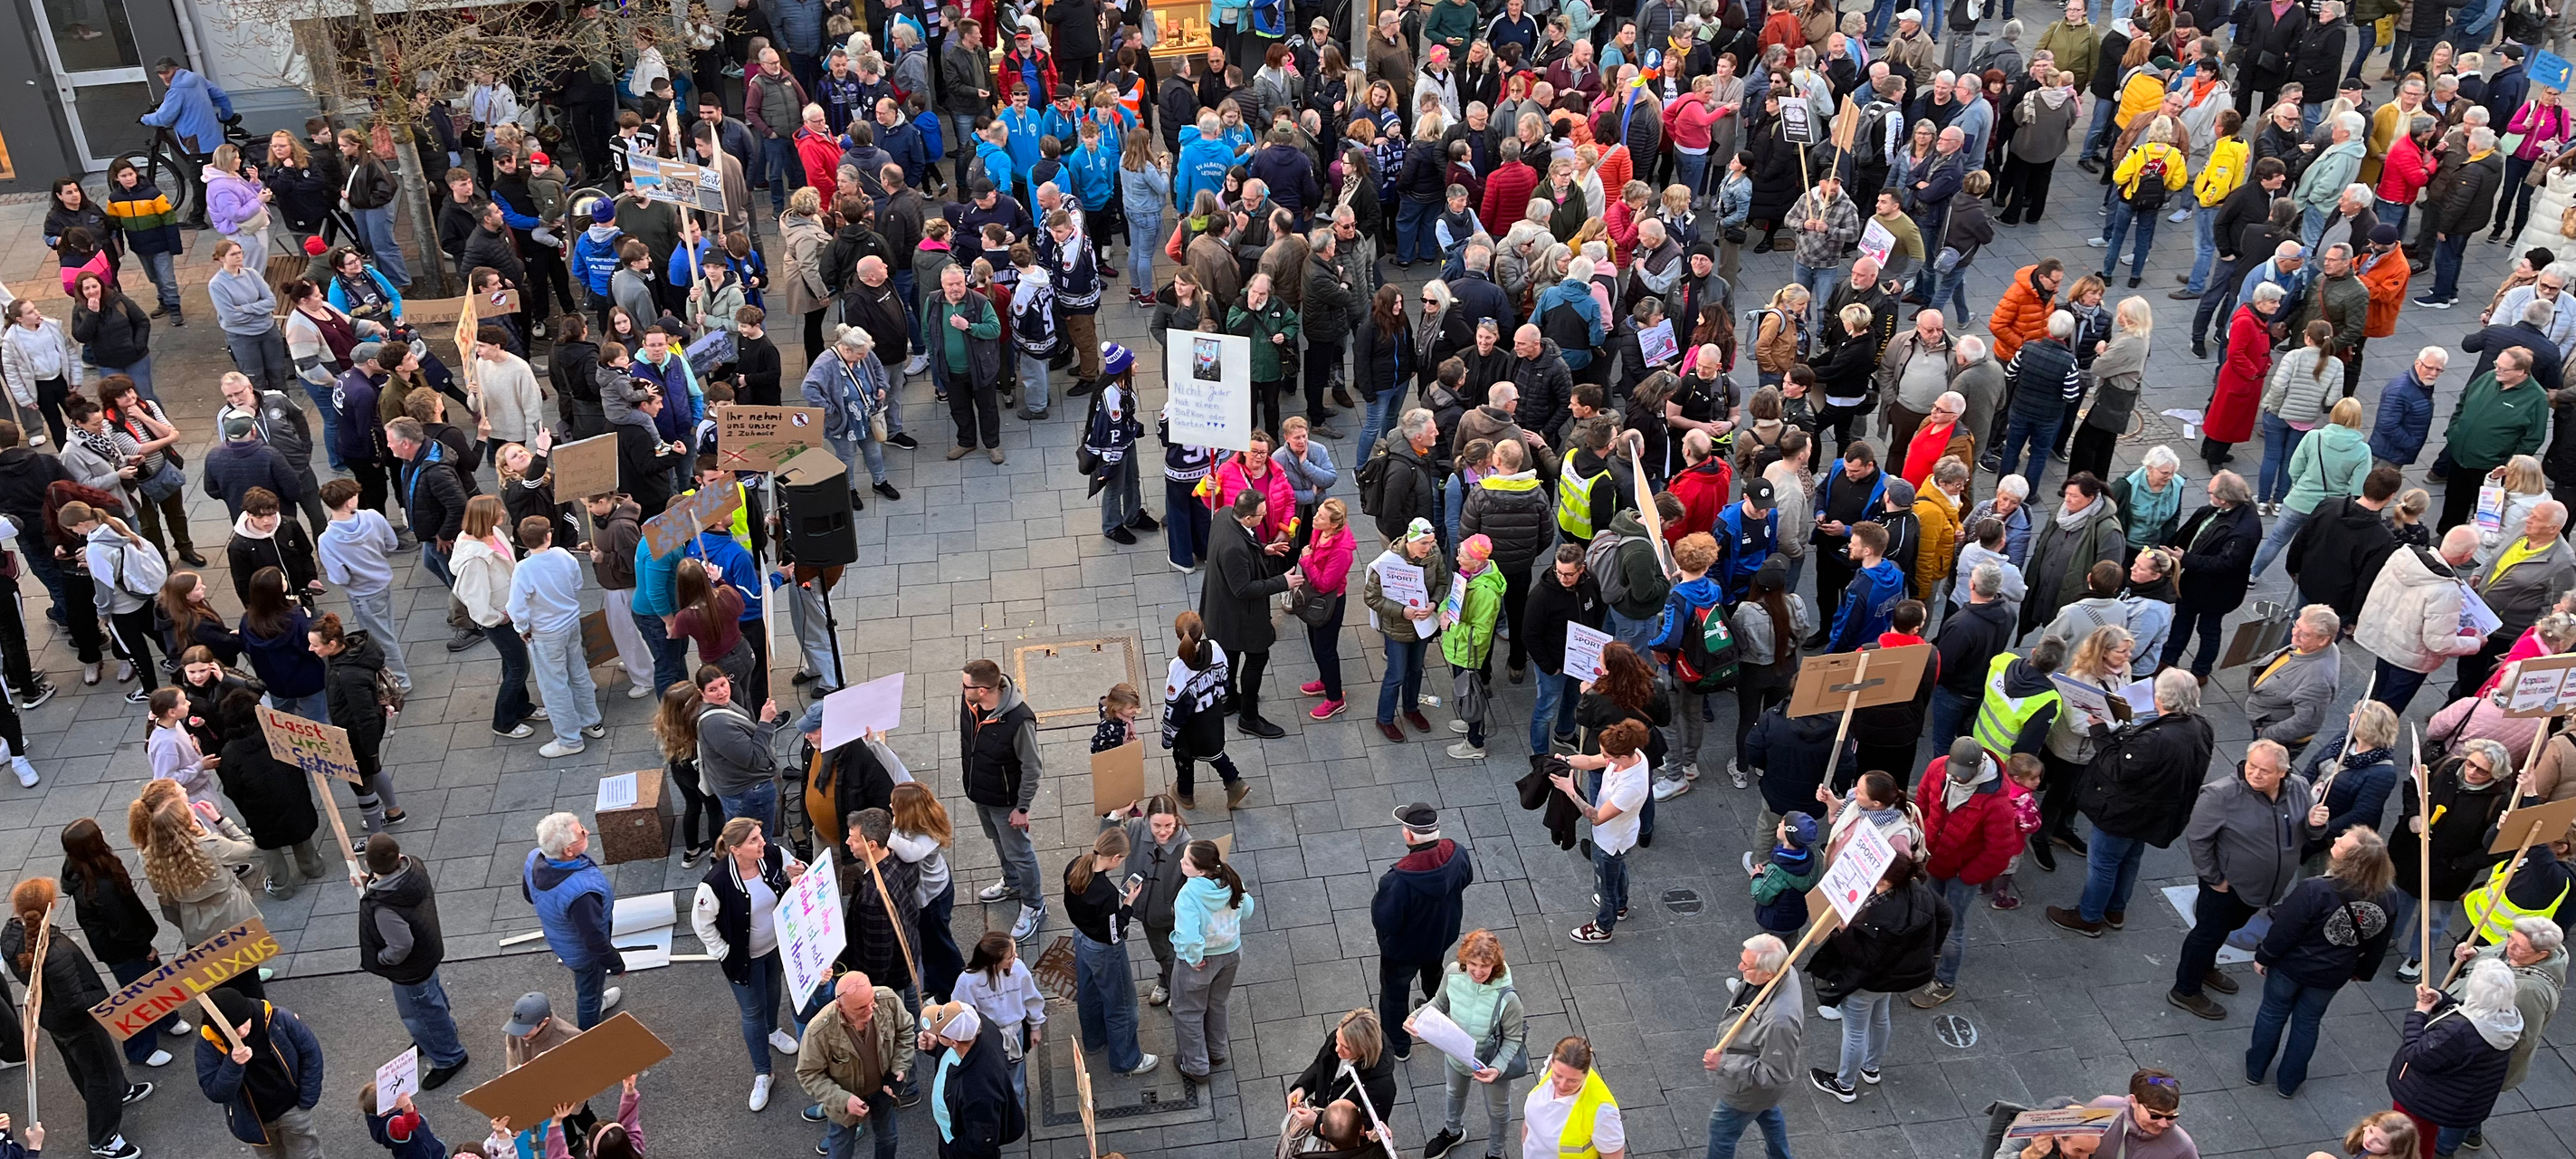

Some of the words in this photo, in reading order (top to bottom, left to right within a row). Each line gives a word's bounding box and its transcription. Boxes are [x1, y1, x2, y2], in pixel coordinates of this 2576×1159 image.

[1174, 382, 1202, 397] Nicht
[1207, 385, 1232, 402] Jeder
[1175, 397, 1189, 407] hat
[1196, 400, 1219, 409] einen
[726, 411, 744, 421] Ihr
[749, 411, 783, 421] nehmt
[1566, 467, 1583, 484] Ordner
[269, 713, 327, 741] Lasst
[288, 734, 332, 753] uns
[782, 900, 794, 923] die
[821, 906, 835, 936] ohne
[787, 920, 799, 944] alte
[806, 923, 820, 942] ist
[94, 926, 248, 1018] SCHWIMMEN
[114, 986, 189, 1036] KEIN
[182, 936, 279, 993] LUXUS
